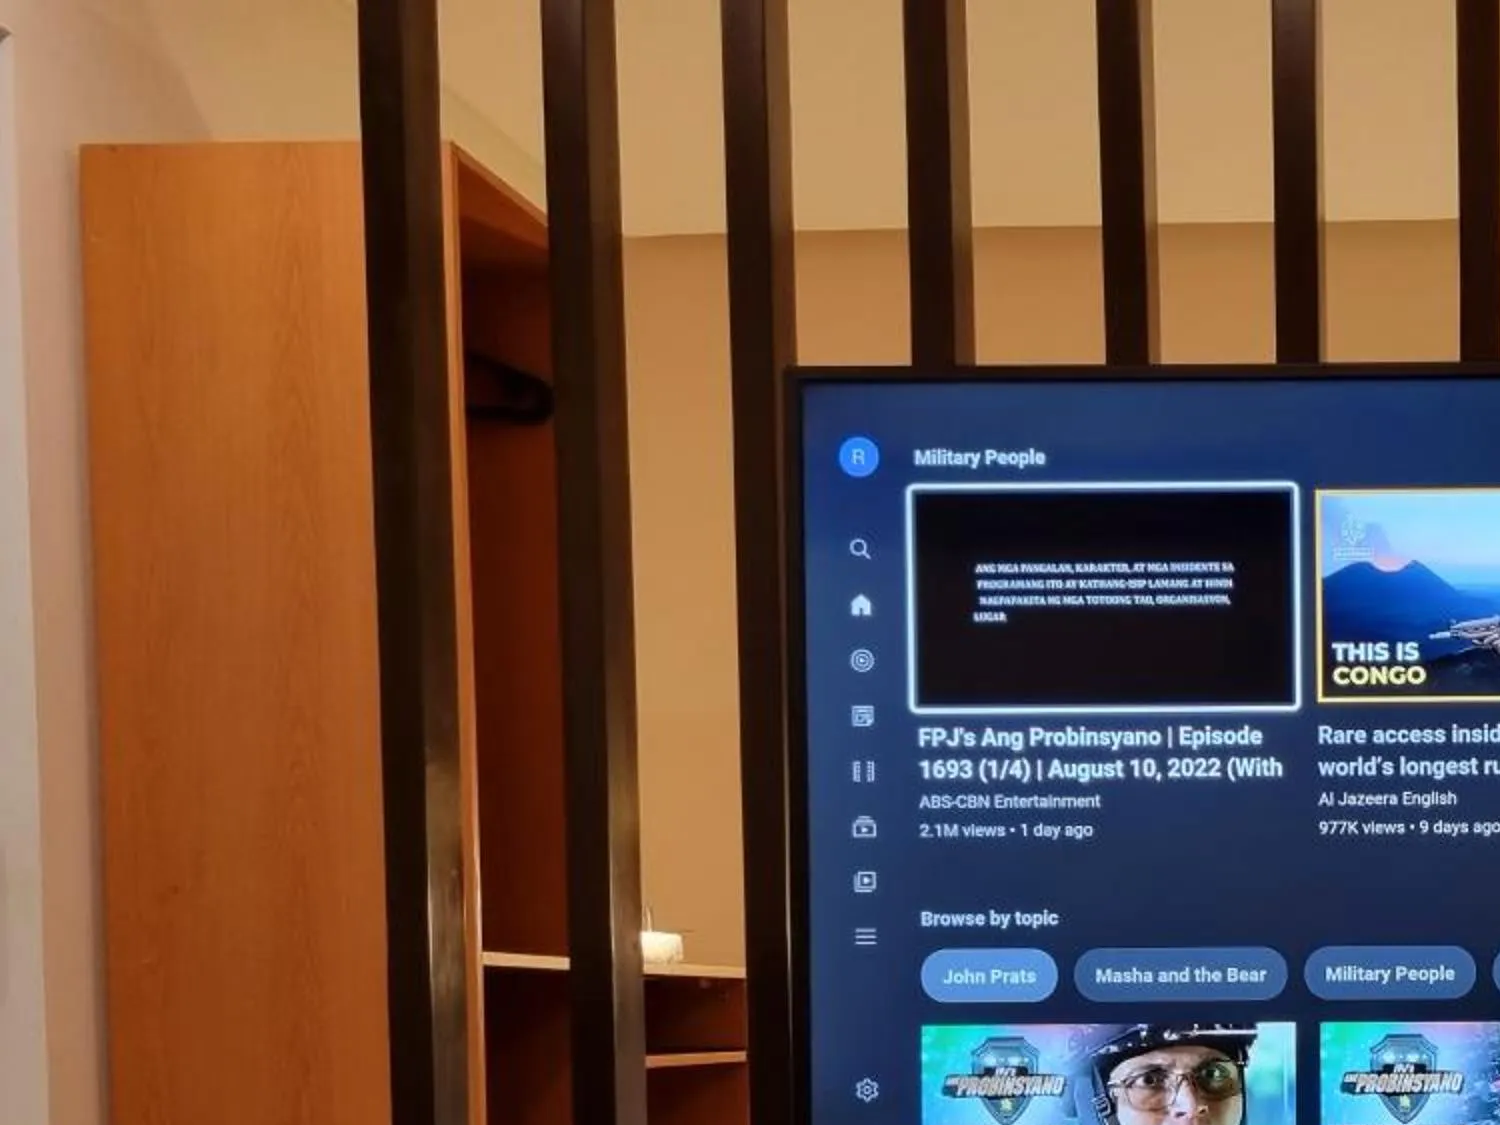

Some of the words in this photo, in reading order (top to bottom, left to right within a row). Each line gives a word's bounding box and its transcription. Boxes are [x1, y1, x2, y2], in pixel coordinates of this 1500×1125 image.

[914, 449, 980, 469] Military
[985, 449, 1045, 469] People
[1332, 642, 1389, 662] THIS
[1397, 642, 1419, 661] IS
[1332, 666, 1427, 687] CONGO
[919, 728, 976, 747] FPJ's
[982, 728, 1023, 751] Ang
[1030, 726, 1161, 751] Probinsyano
[1179, 726, 1262, 749] Episode
[1319, 726, 1366, 744] Rare
[1373, 729, 1446, 743] access
[920, 761, 972, 779] 1693
[979, 760, 1030, 782] (1/4)
[1048, 759, 1124, 783] August
[1131, 760, 1161, 781] 10,
[1168, 759, 1221, 778] 2022
[1228, 758, 1282, 781] (With
[1319, 756, 1394, 776] world's
[1401, 756, 1479, 779] longest
[920, 796, 990, 809] ABS-CBN
[995, 794, 1100, 809] Entertainment
[1319, 792, 1334, 806] Al
[1338, 792, 1398, 806] Jazeera
[1402, 791, 1457, 808] English
[920, 824, 958, 837] 2.1M
[963, 824, 1005, 837] views
[1021, 824, 1028, 836] 1
[1034, 824, 1060, 839] day
[1065, 826, 1092, 839] ago
[1319, 822, 1359, 835] 977K
[1363, 822, 1404, 834] views
[1420, 821, 1428, 834] 9
[1434, 821, 1469, 836] days
[921, 912, 985, 926] Browse
[990, 910, 1010, 929] by
[1015, 910, 1059, 928] topic
[944, 969, 985, 985] John
[991, 969, 1036, 984] Prats
[1096, 968, 1152, 983] Masha
[1159, 967, 1189, 983] and
[1195, 967, 1222, 983] the
[1227, 967, 1266, 983] Bear
[1326, 965, 1391, 984] Military
[1396, 965, 1454, 984] People
